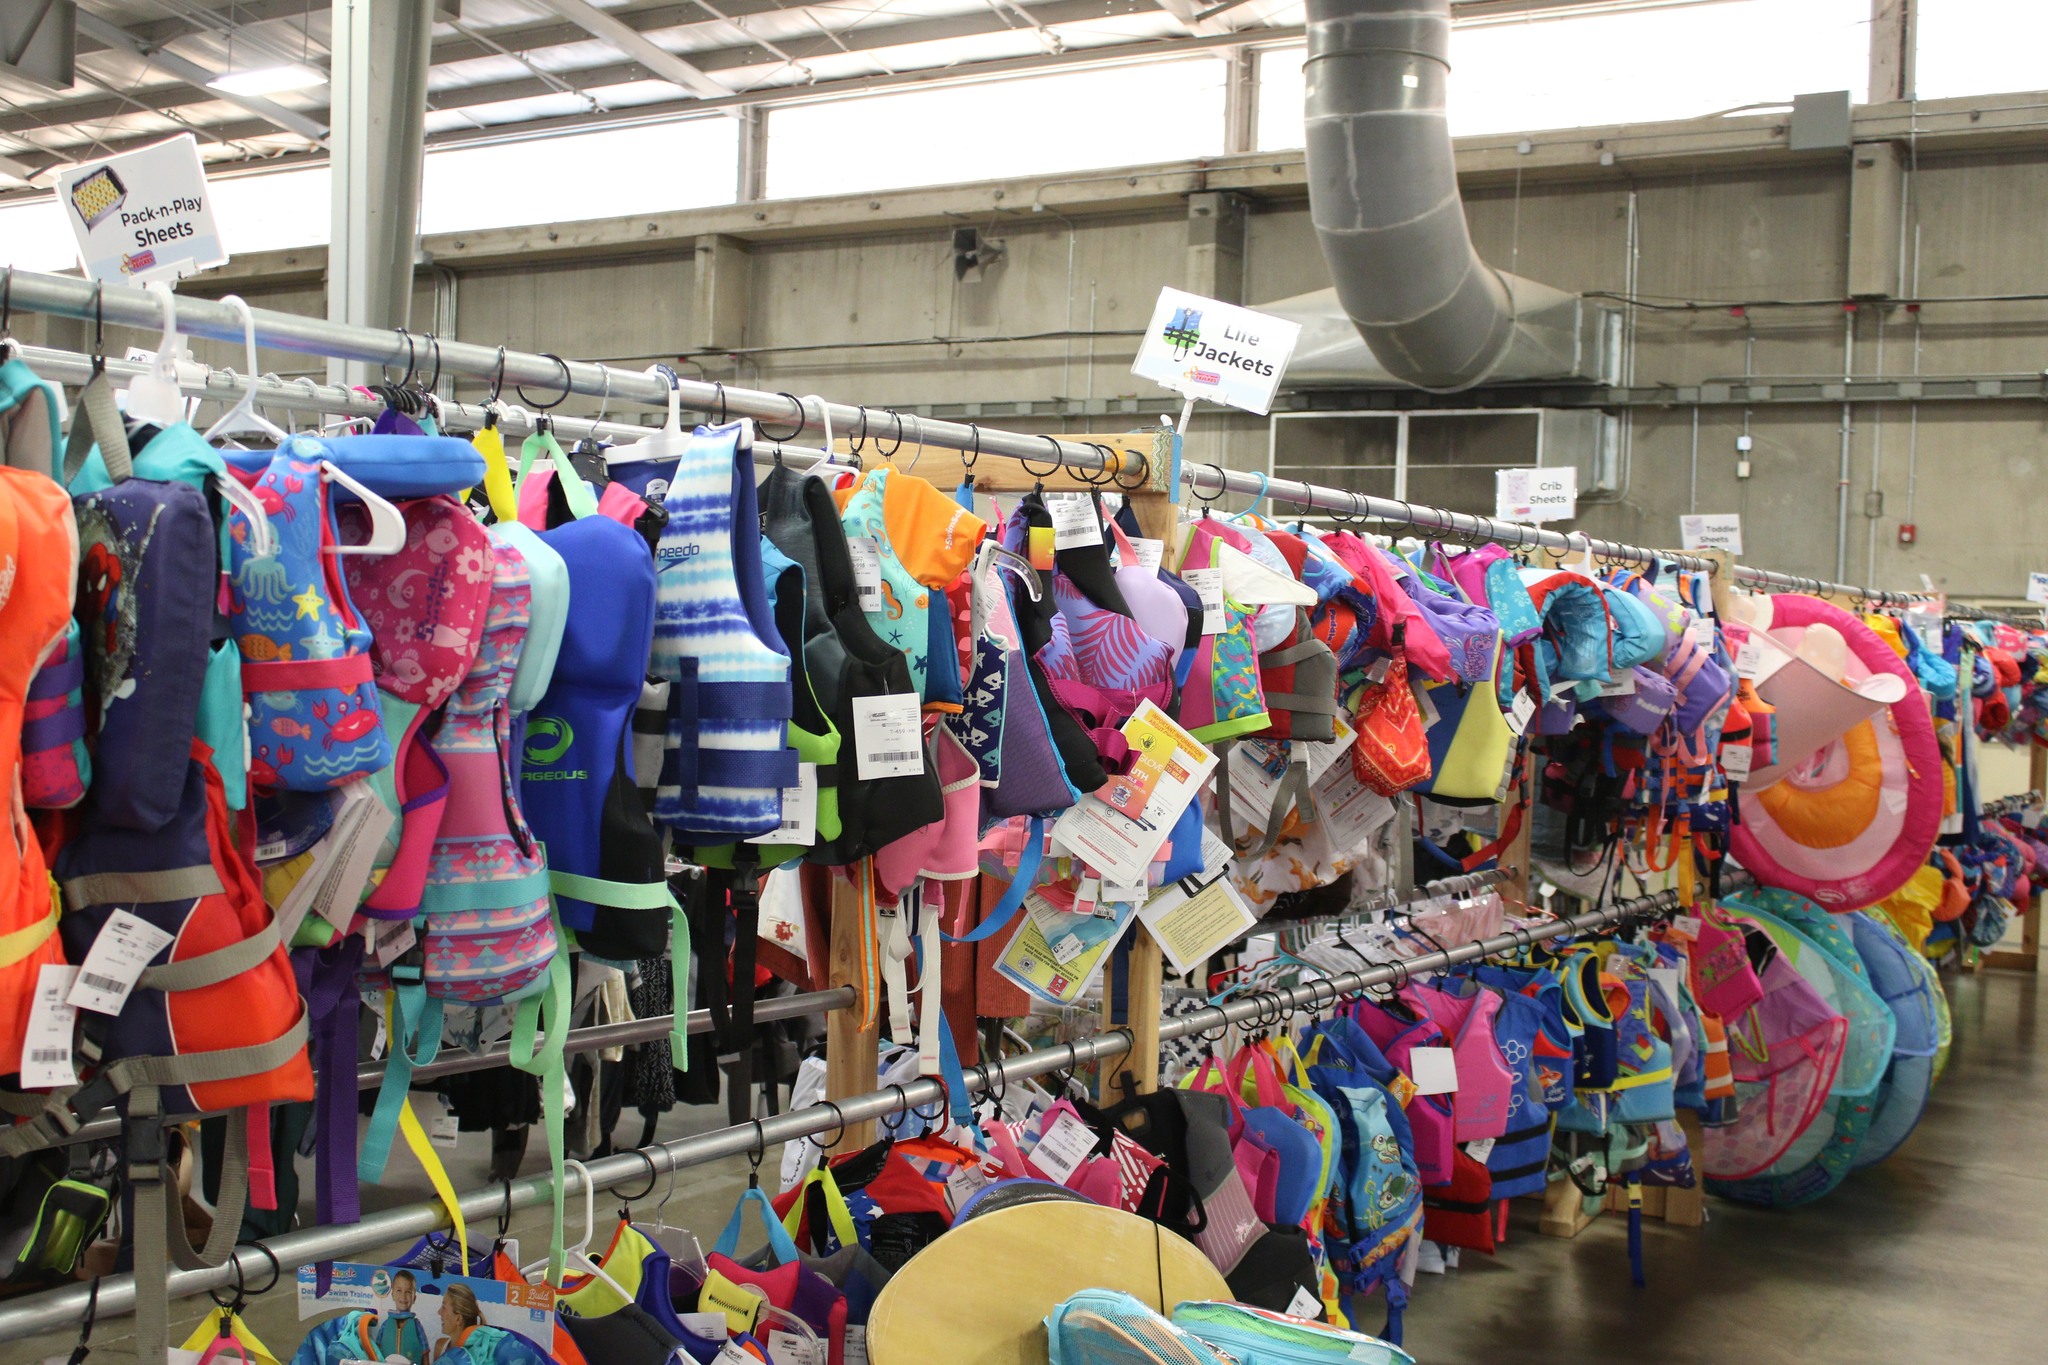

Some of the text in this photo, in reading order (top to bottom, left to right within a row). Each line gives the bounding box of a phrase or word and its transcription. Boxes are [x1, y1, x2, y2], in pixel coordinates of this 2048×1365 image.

[121, 197, 202, 227] Pack-n-Play
[135, 221, 194, 247] Sheets
[1194, 342, 1274, 377] Jackets
[1540, 481, 1562, 491] Crib
[1530, 495, 1567, 505] Sheets
[1705, 525, 1738, 533] Toddler
[1700, 535, 1729, 544] Sheets
[1175, 731, 1203, 757] INFORMATION
[1139, 754, 1164, 773] GLOVE
[521, 770, 588, 782] AGEOUS
[1130, 768, 1149, 782] UTH
[350, 1291, 374, 1299] Trainer
[511, 1290, 519, 1304] 2
[528, 1288, 549, 1301] Build
